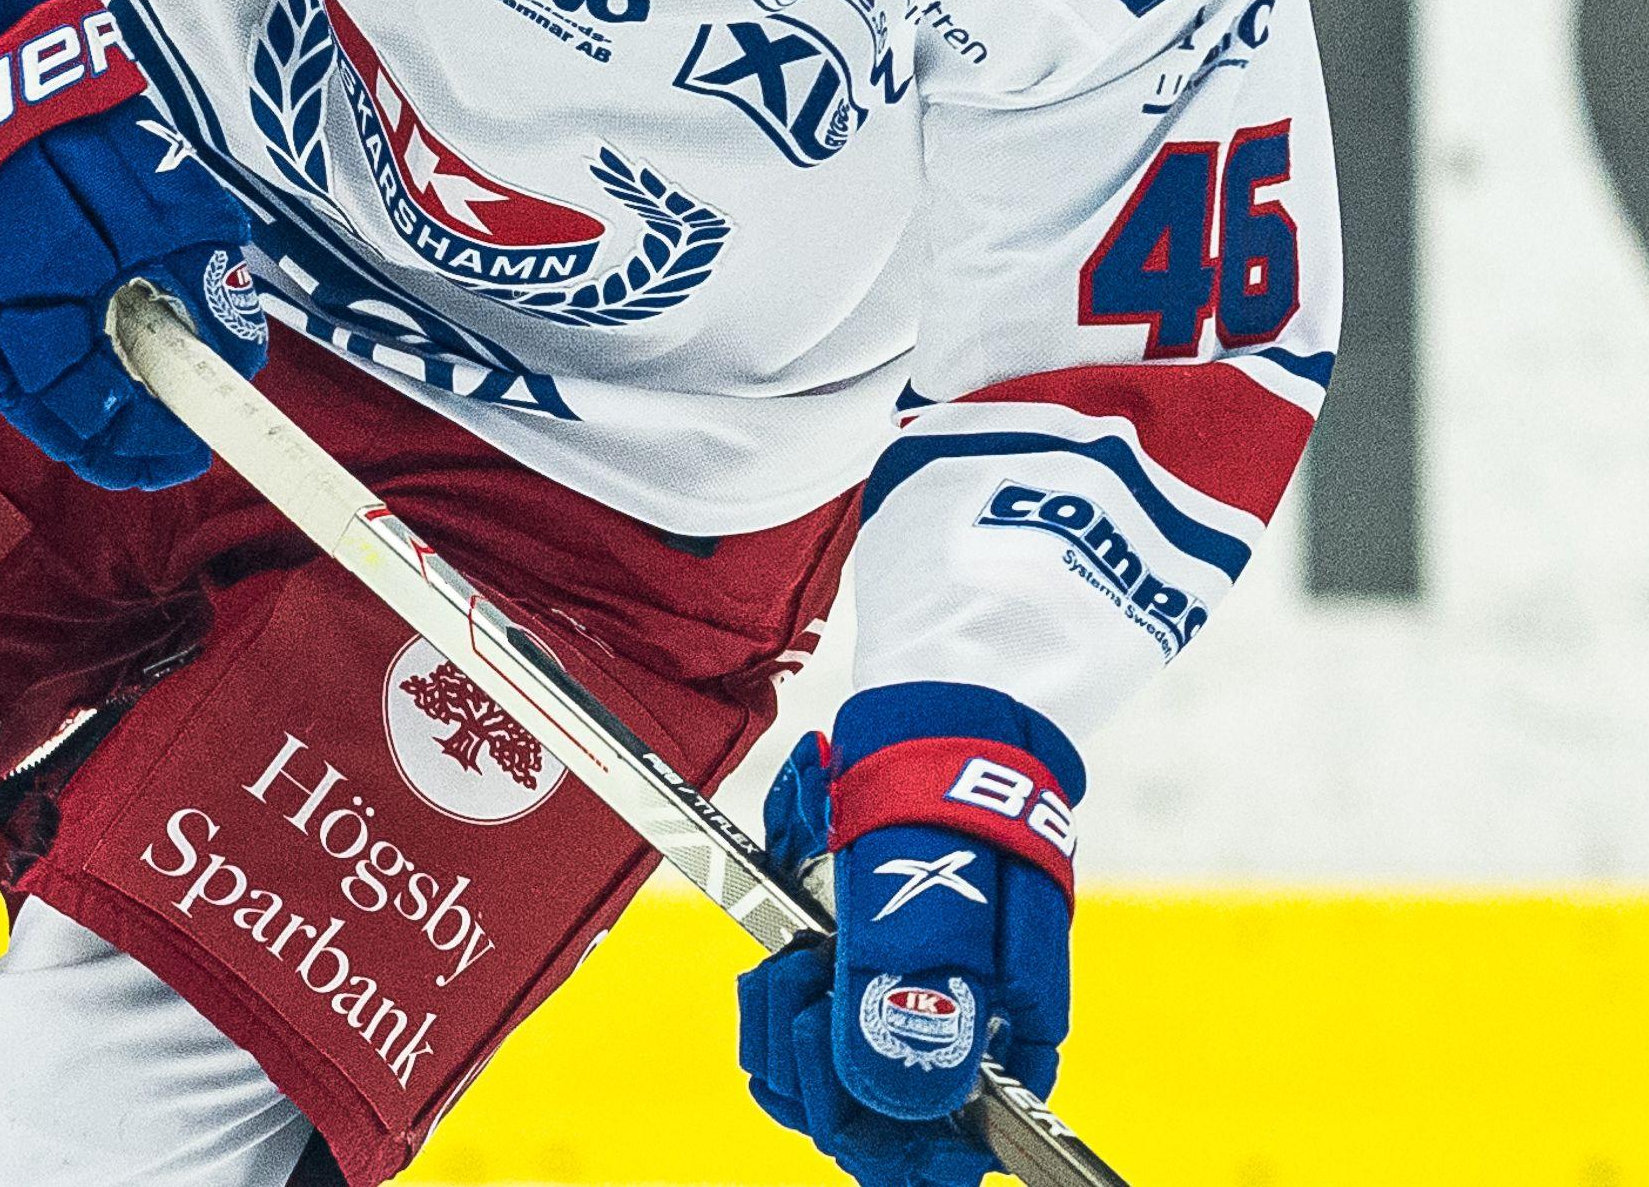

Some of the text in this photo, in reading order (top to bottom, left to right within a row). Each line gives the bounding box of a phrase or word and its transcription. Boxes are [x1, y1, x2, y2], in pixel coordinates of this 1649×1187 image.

[575, 40, 612, 63] AB
[340, 58, 577, 280] SKARSHAMN
[1078, 118, 1300, 361] 46
[1062, 549, 1121, 607] Systems
[139, 808, 437, 1090] Sparbank
[243, 731, 496, 987] Högsby
